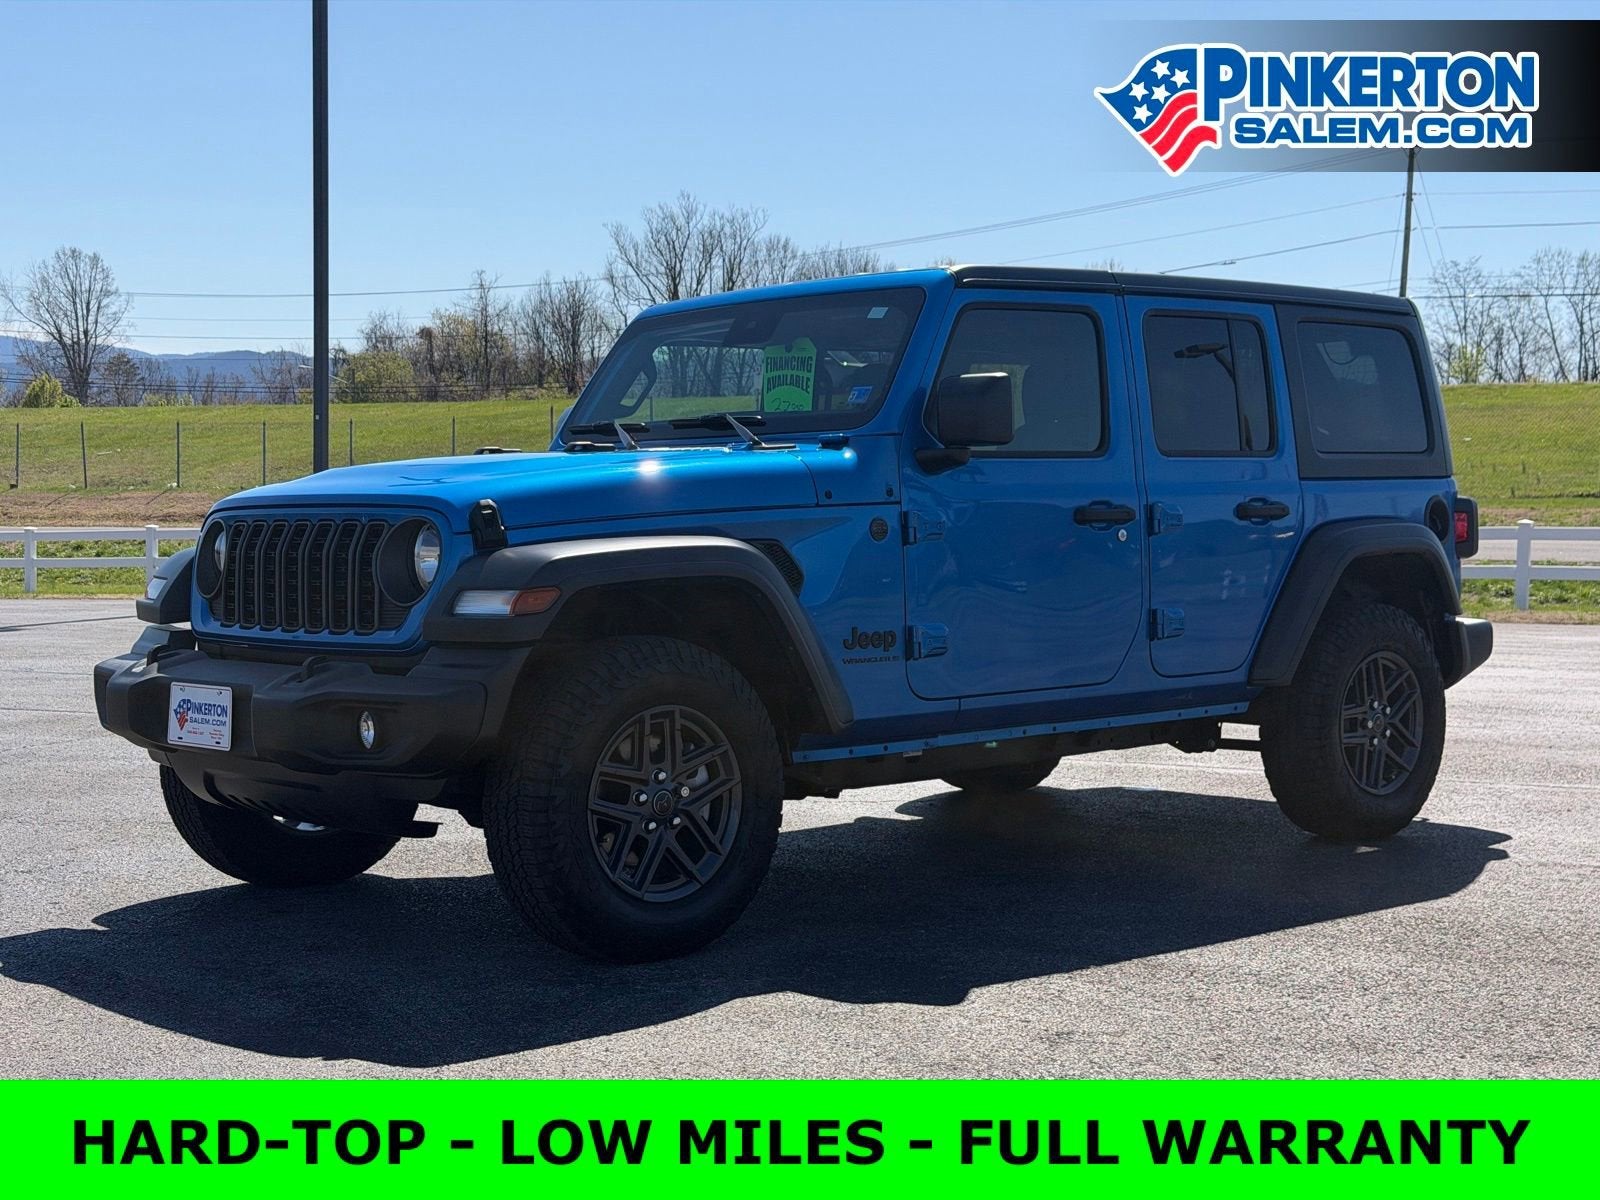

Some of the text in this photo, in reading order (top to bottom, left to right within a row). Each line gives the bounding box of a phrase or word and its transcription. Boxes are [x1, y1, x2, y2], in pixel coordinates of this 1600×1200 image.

[765, 355, 813, 374] FINANCING
[766, 374, 811, 394] AVAILABLE
[842, 626, 896, 652] Jeep
[186, 699, 228, 718] PINKERTON
[189, 716, 227, 727] SALEM.COM
